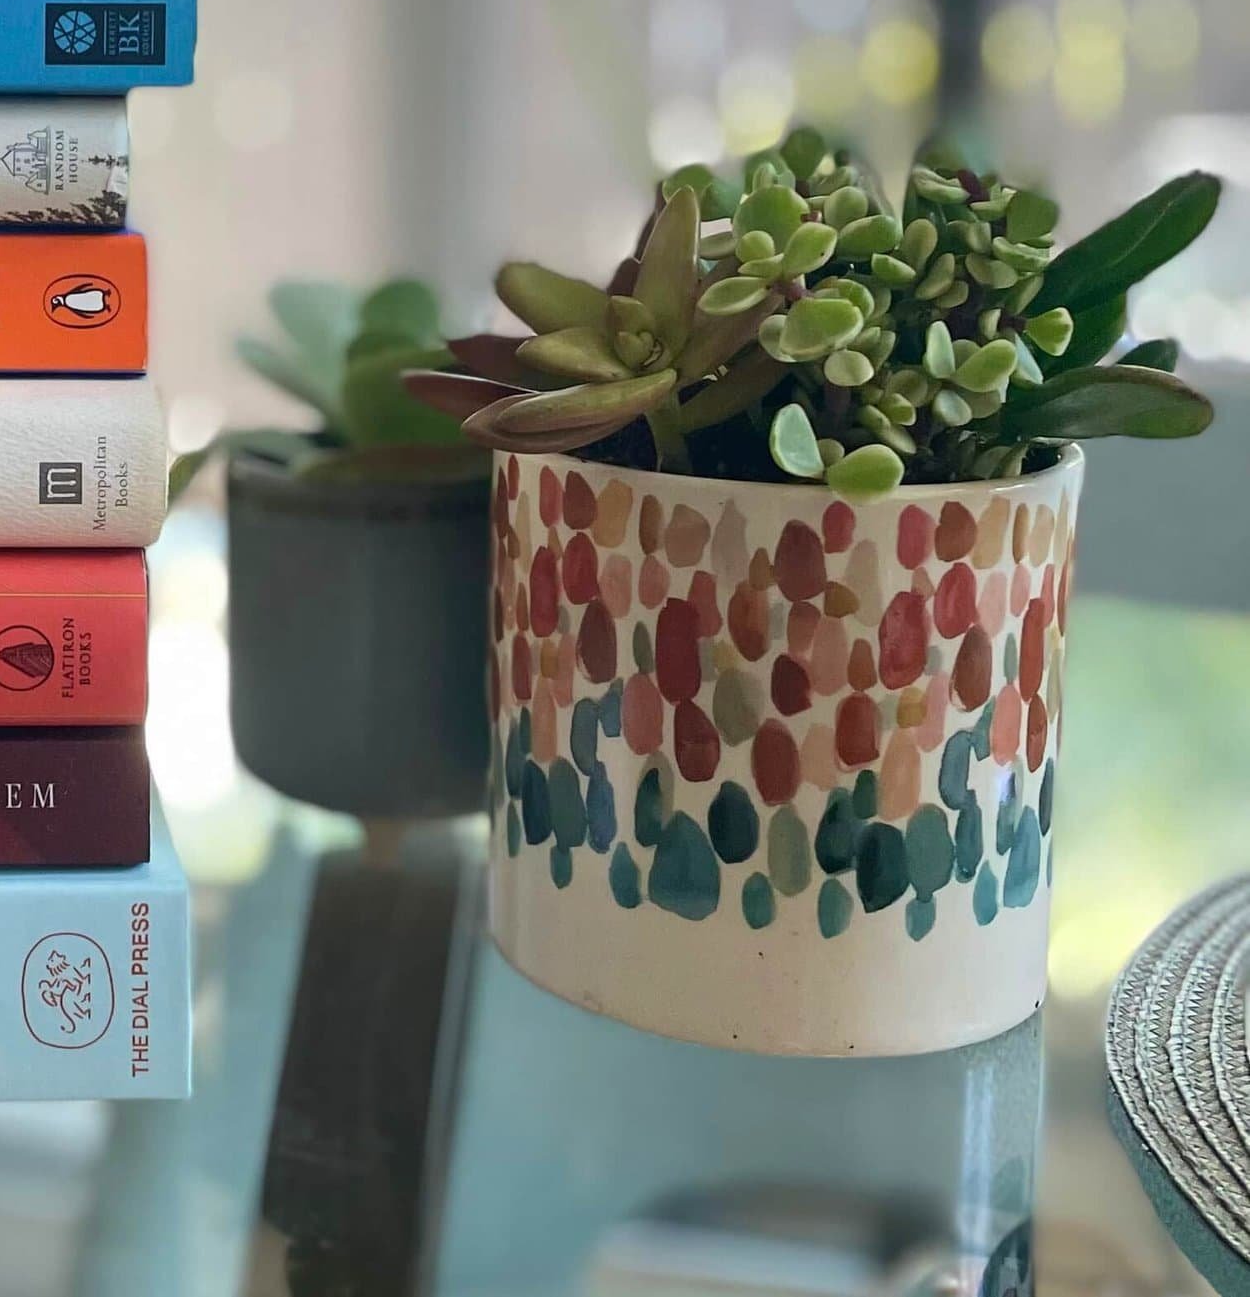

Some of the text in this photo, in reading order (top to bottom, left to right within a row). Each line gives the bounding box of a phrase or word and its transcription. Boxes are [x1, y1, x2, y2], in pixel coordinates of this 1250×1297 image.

[119, 10, 139, 54] BK
[55, 130, 65, 191] RANDOM
[69, 138, 78, 183] HOUSE
[93, 436, 110, 531] Metropolitan
[115, 461, 128, 507] Books
[62, 618, 74, 698] FLATIRON
[79, 632, 91, 685] BOOKS
[132, 902, 149, 1077] THE DIAL PRESS
